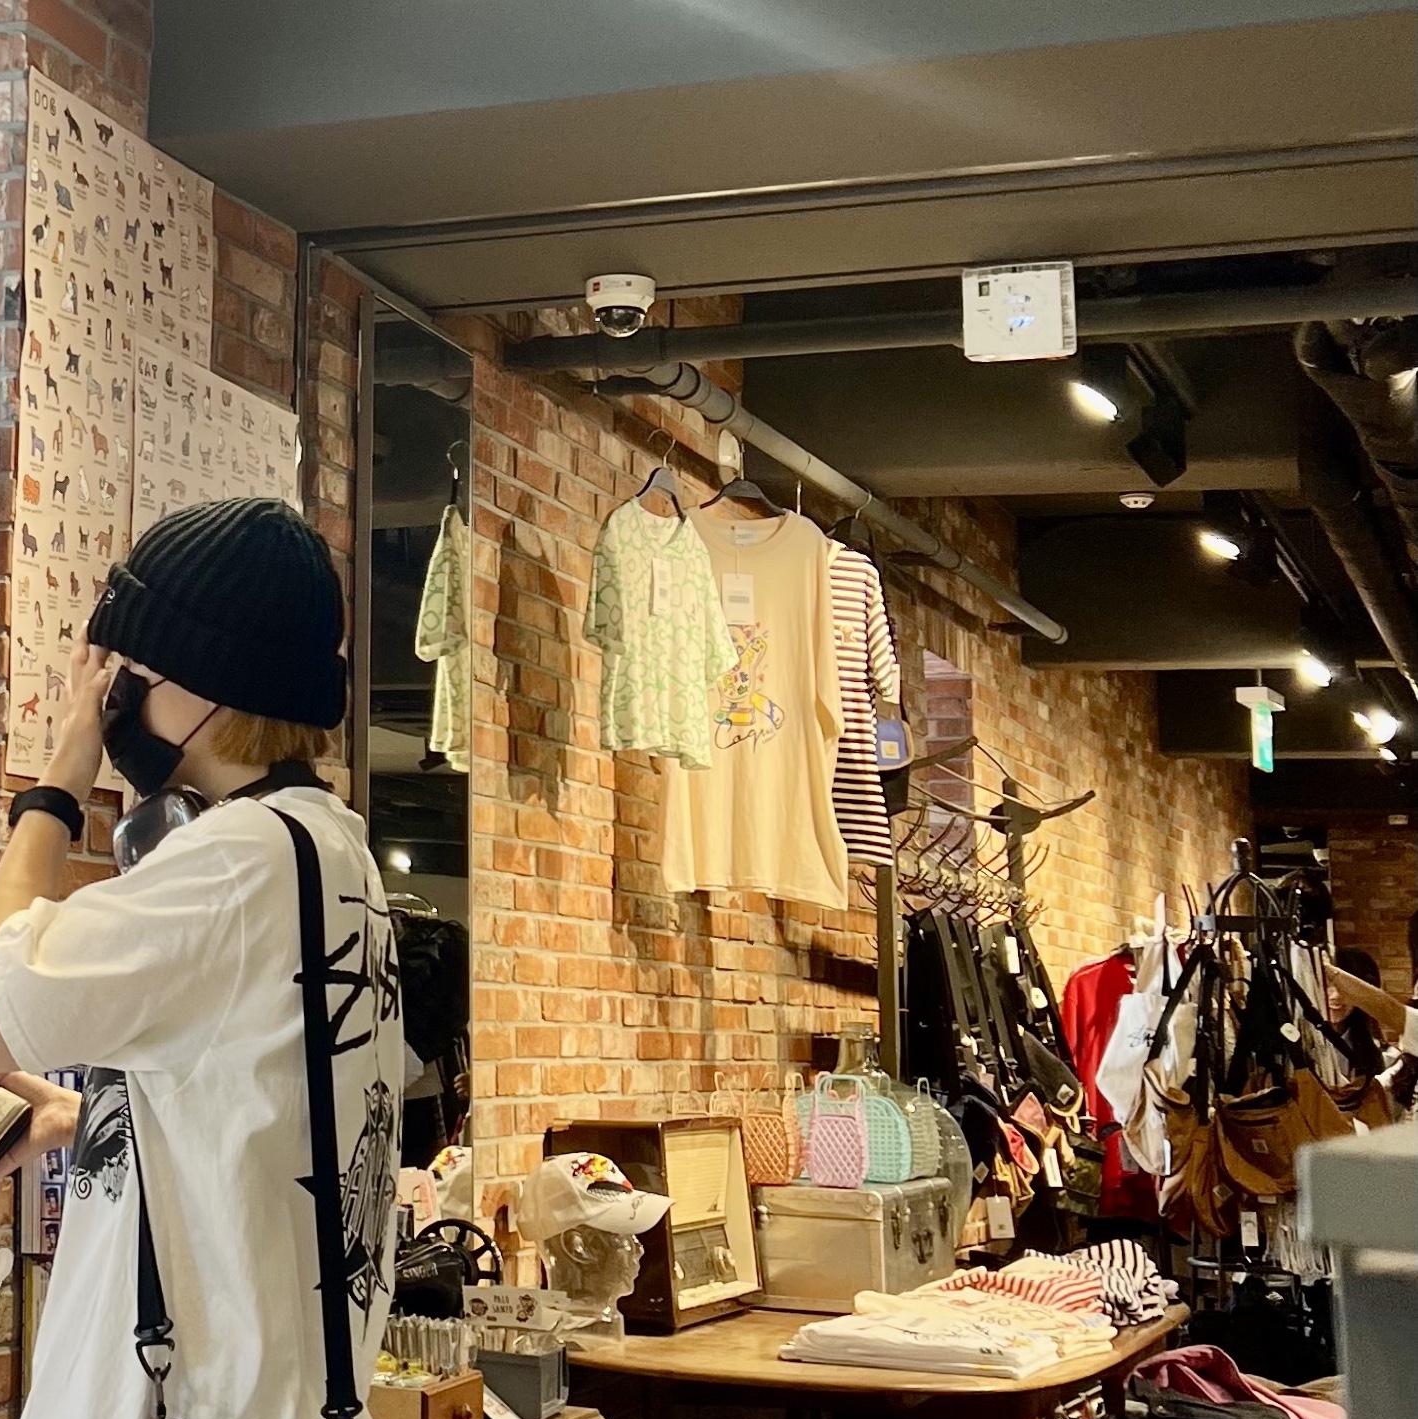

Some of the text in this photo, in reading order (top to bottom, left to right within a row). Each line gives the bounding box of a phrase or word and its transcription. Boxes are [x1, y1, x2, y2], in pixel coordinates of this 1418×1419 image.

[34, 89, 57, 117] DOG
[138, 356, 158, 380] CAT
[402, 1260, 439, 1280] SINGER
